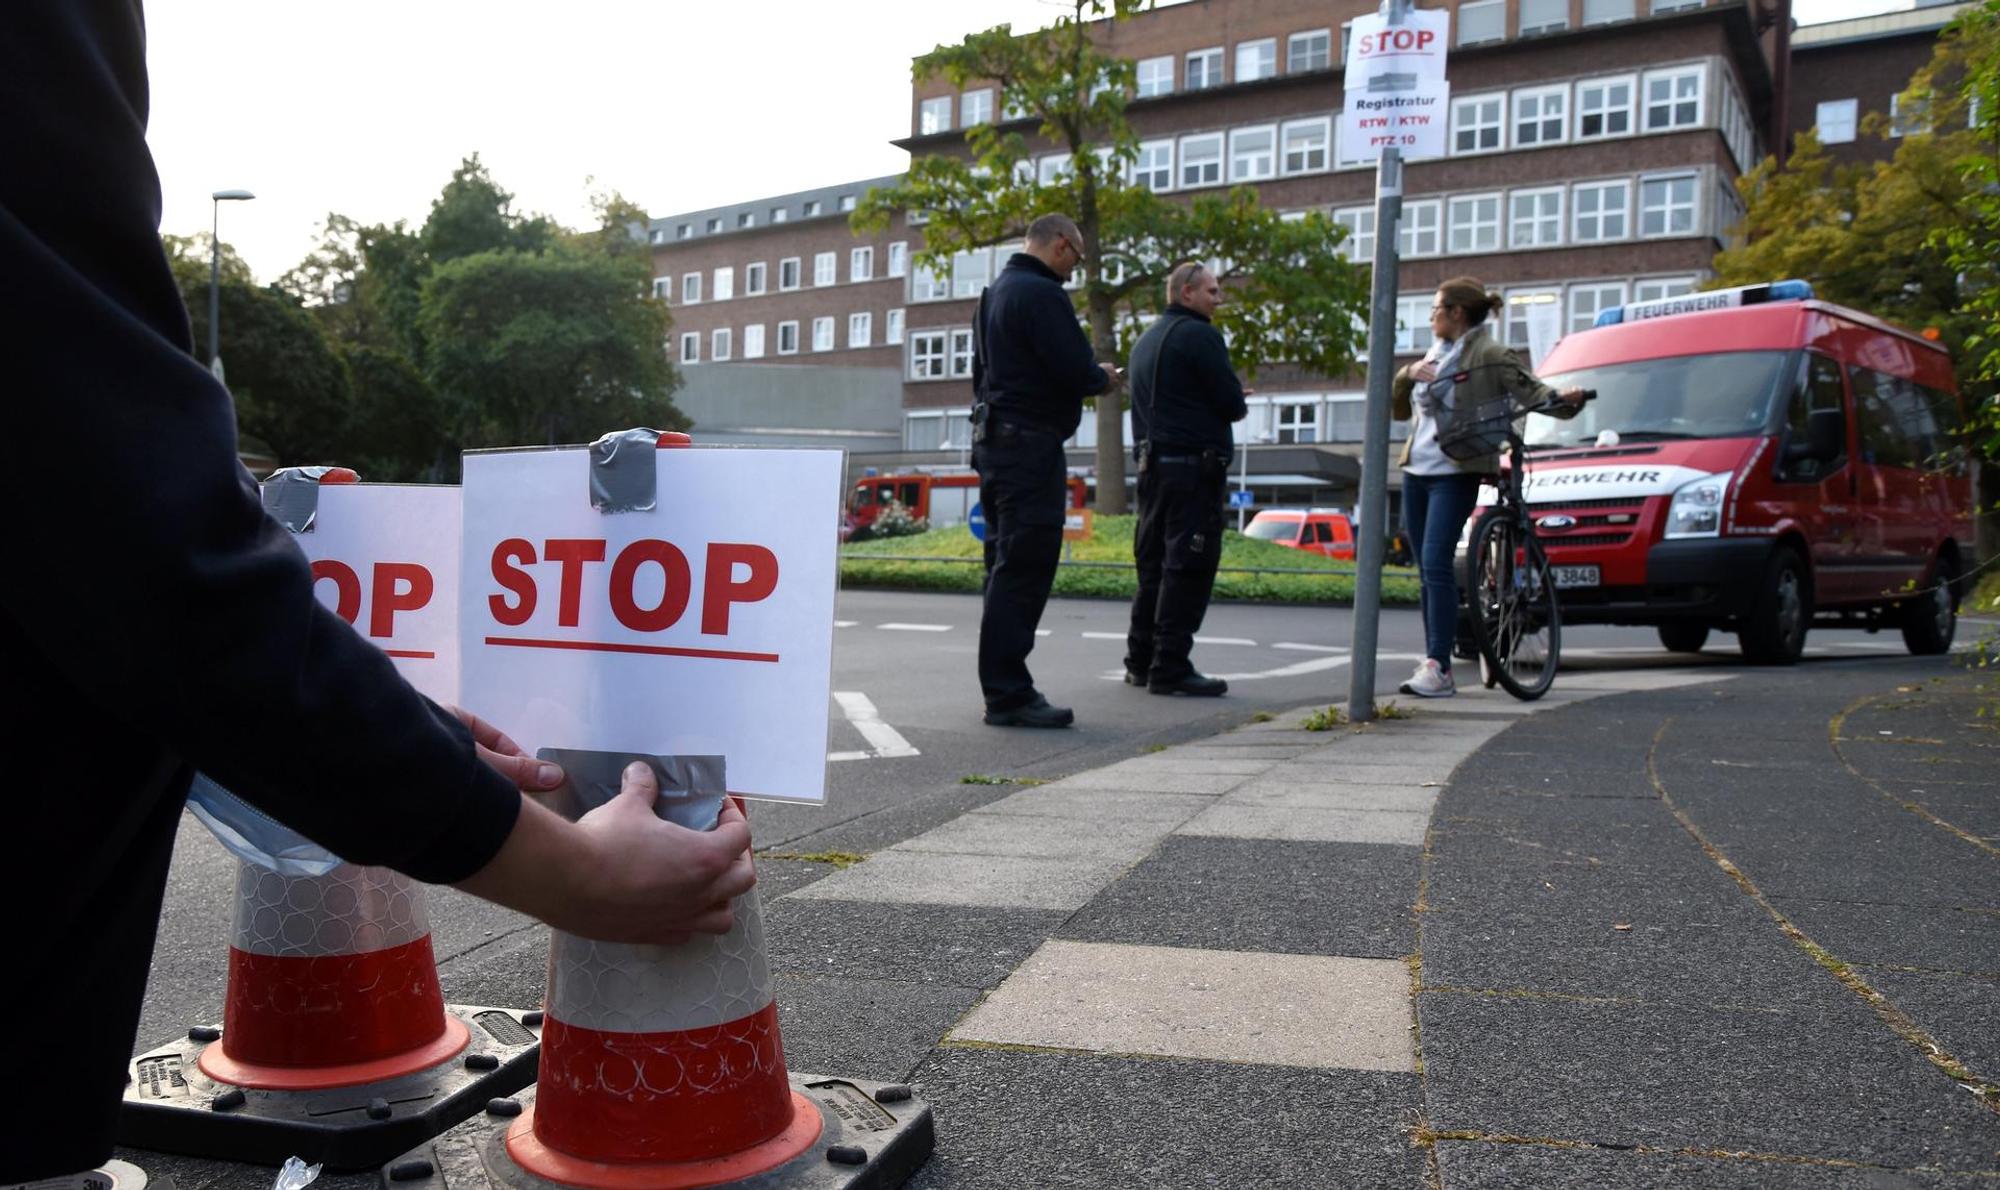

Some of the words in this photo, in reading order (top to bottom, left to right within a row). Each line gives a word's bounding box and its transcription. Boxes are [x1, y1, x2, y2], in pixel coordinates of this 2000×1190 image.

[1359, 29, 1434, 54] STOP
[1356, 96, 1436, 111] Registratur
[1359, 117, 1388, 128] RTW
[1400, 116, 1430, 126] KTW
[1371, 136, 1395, 146] PTZ
[1401, 135, 1416, 145] 10
[1633, 293, 1728, 320] FEUERWEHR
[1535, 471, 1660, 487] ERWEHR
[488, 538, 779, 635] STOP
[309, 560, 434, 638] OP
